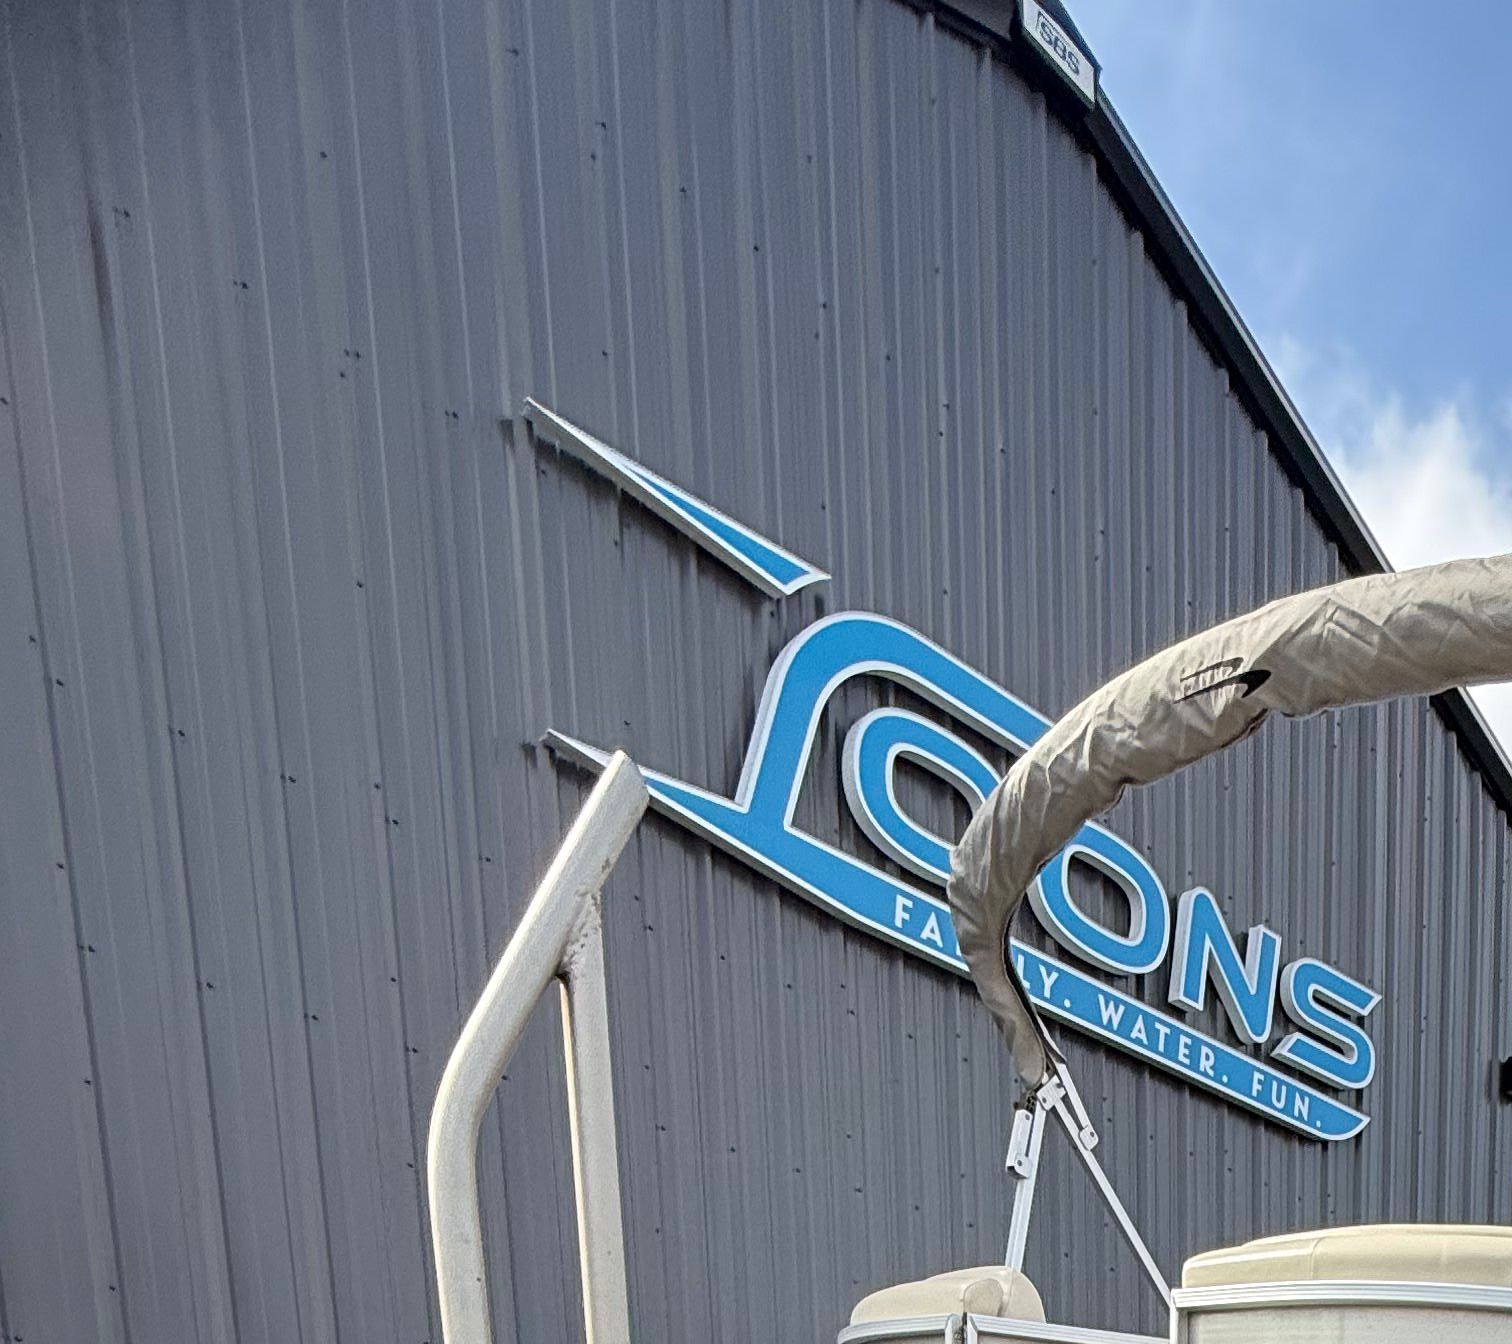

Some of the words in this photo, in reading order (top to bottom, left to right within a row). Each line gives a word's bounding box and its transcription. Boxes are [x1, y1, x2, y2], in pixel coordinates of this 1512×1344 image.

[894, 894, 1071, 1008] FALY.
[1098, 993, 1229, 1084] WATER.
[1251, 1070, 1322, 1128] FUN.
